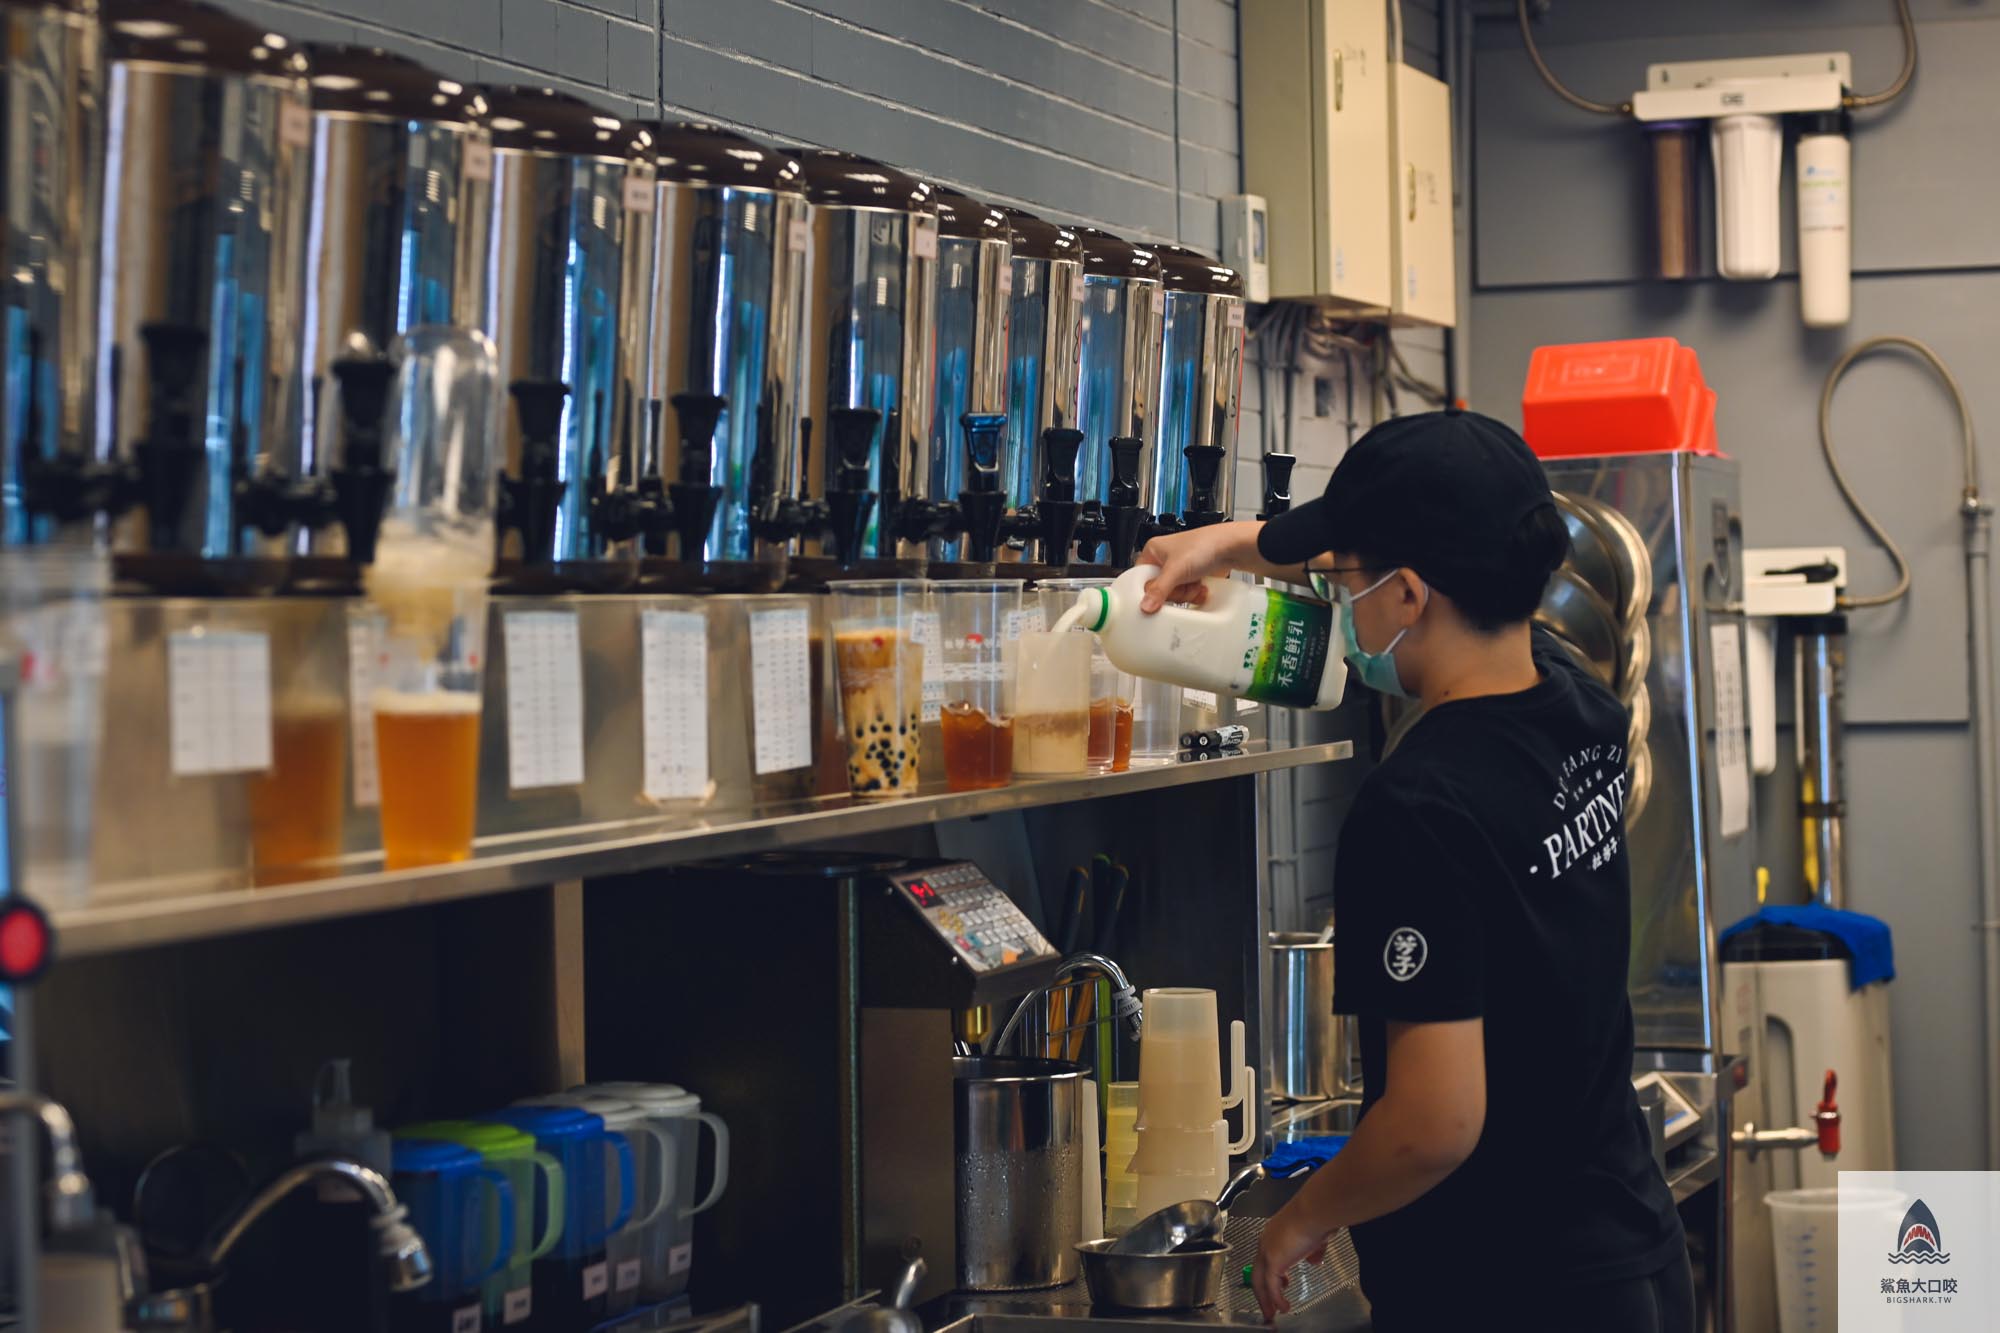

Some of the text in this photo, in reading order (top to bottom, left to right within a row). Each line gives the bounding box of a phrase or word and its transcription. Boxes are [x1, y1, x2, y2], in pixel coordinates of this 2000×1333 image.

[1278, 619, 1305, 688] 禾香鮮乳
[1543, 768, 1629, 879] PARTNE
